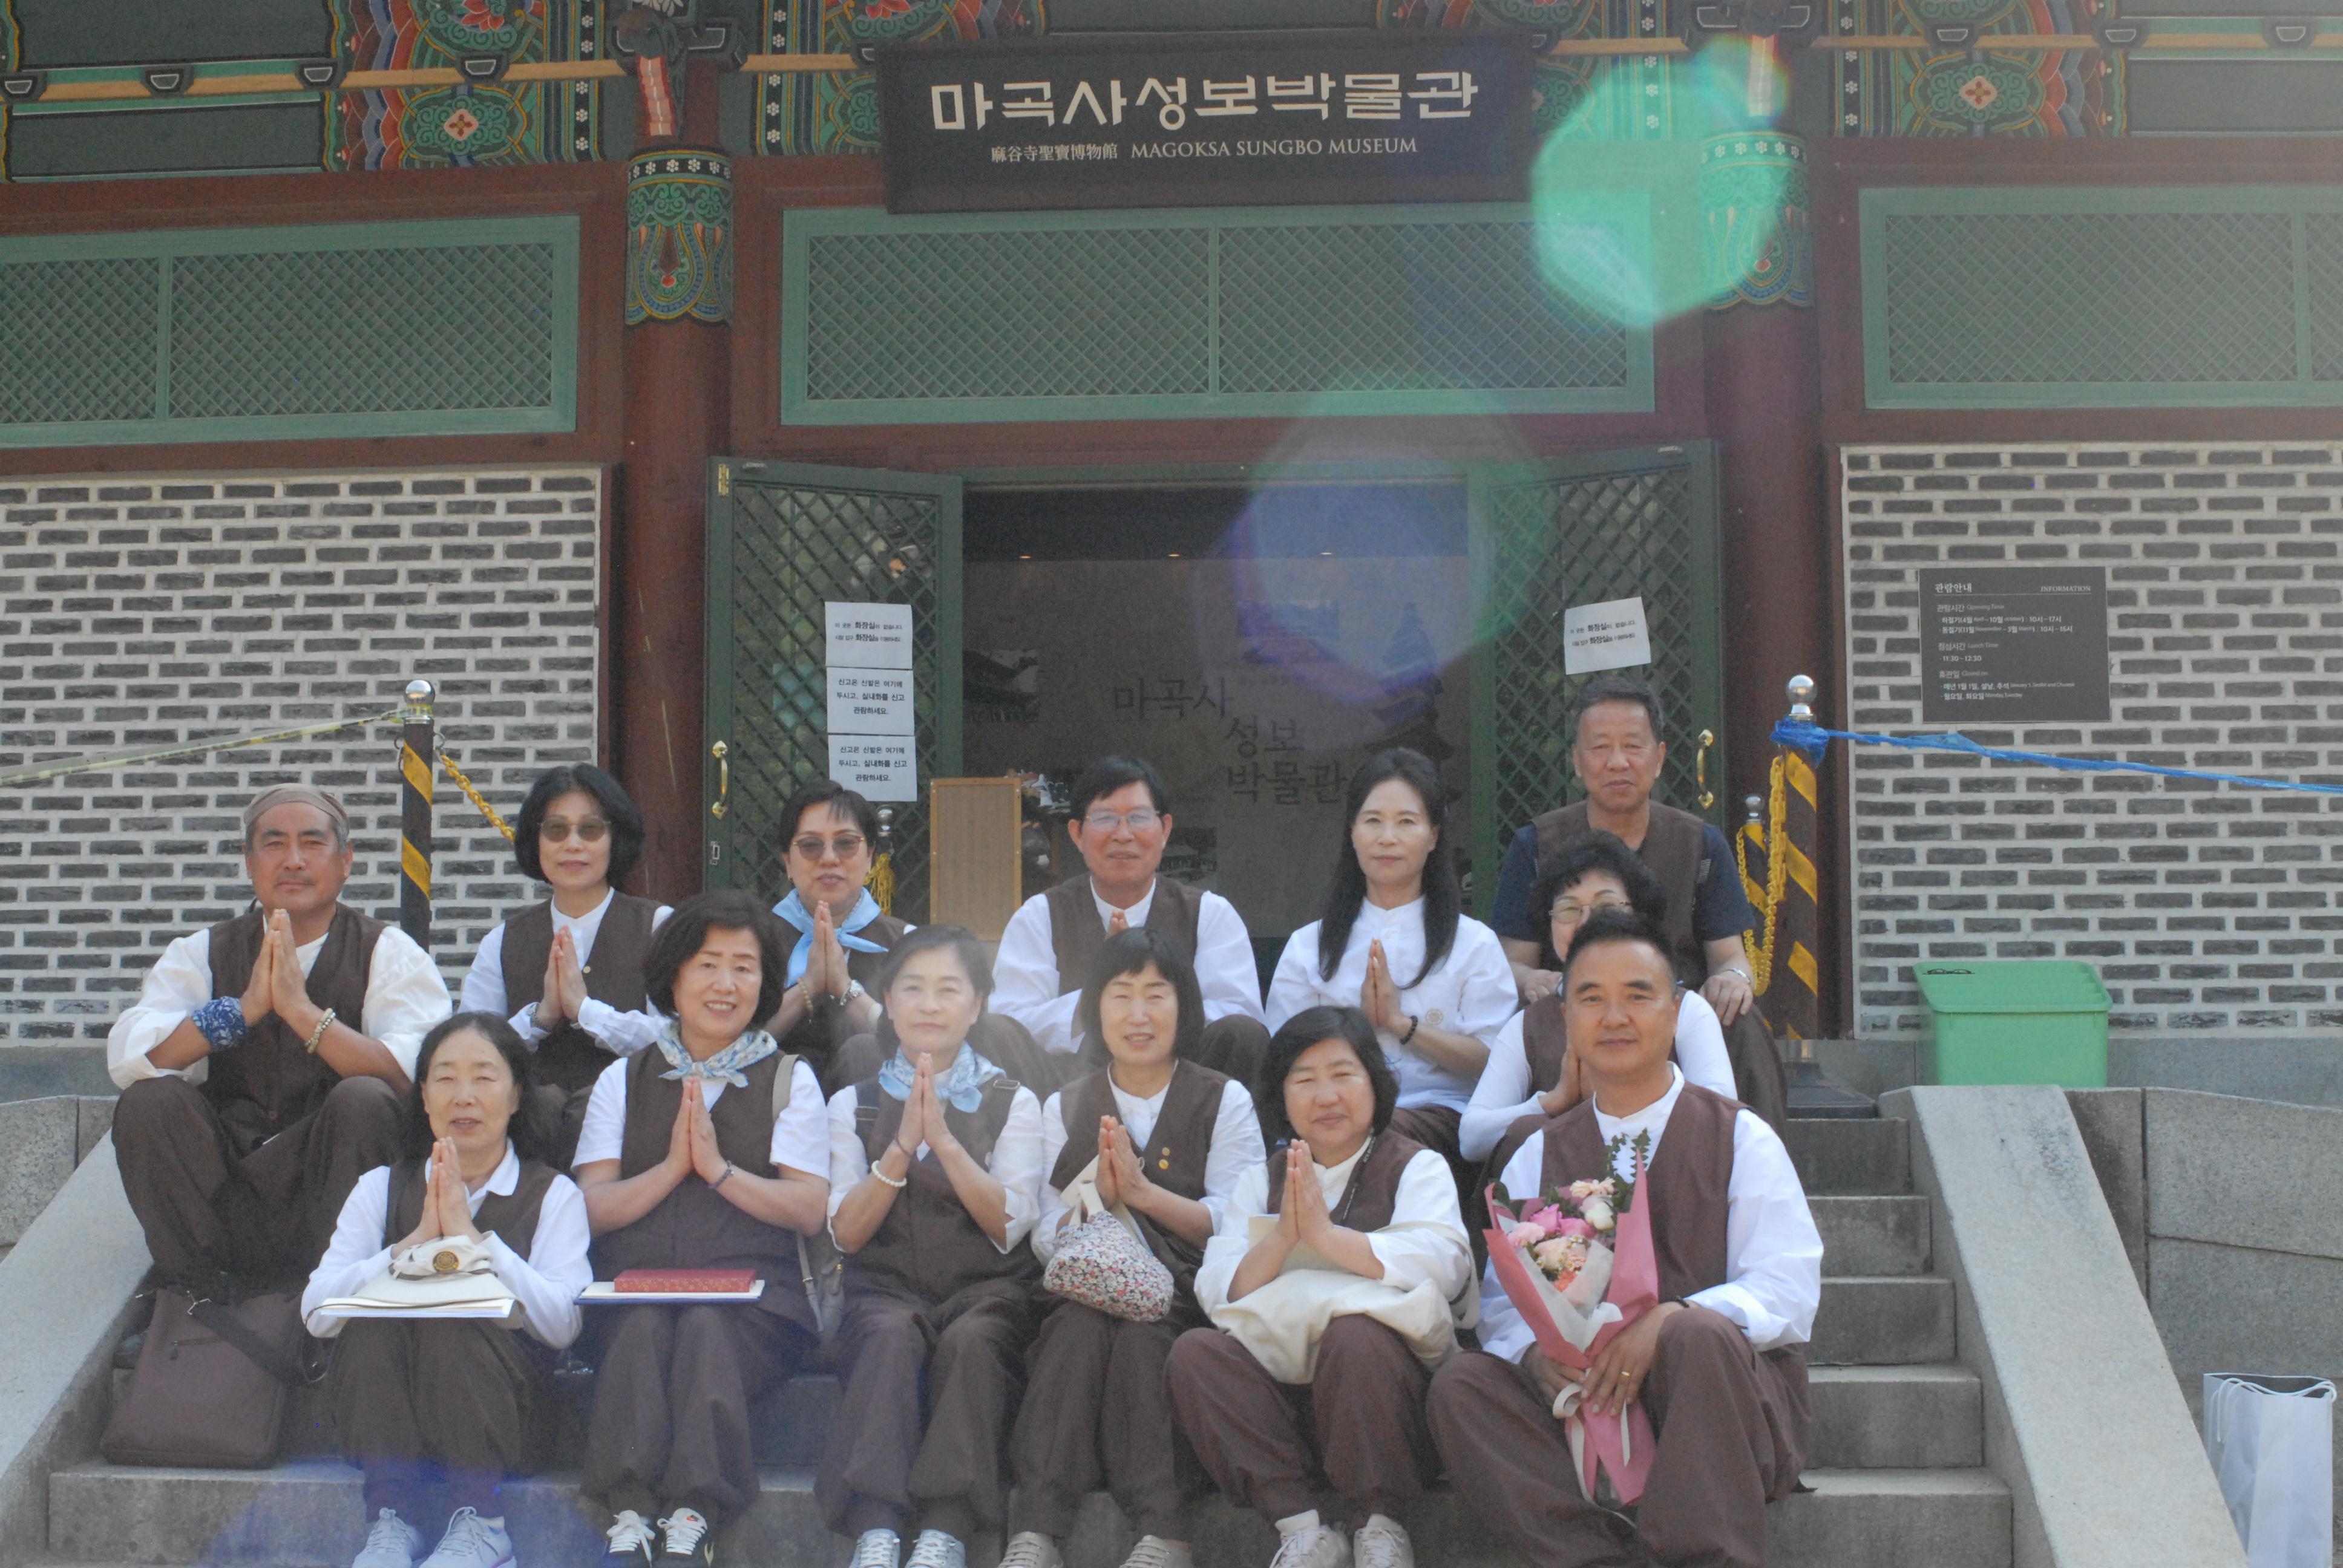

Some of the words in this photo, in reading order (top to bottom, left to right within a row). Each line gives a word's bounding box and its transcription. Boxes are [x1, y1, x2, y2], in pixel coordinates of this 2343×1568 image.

[930, 71, 1479, 131] 마곡사성보박물관
[1130, 140, 1231, 158] MAGOKSA
[1236, 139, 1323, 157] SUNGBO
[1328, 137, 1418, 154] MUSEUM
[1935, 583, 1972, 593] 관람안내
[1937, 604, 1965, 613] 관람시간
[861, 679, 880, 687] 신발은
[862, 693, 889, 701] 실내화를
[891, 693, 905, 702] 신고
[1113, 677, 1233, 719] 마곡사
[853, 706, 890, 714] 관람하세요.
[1224, 715, 1305, 759] 성보
[894, 760, 908, 768] 신고
[855, 774, 891, 782] 관람하세요.
[1227, 760, 1348, 805] 박물관
